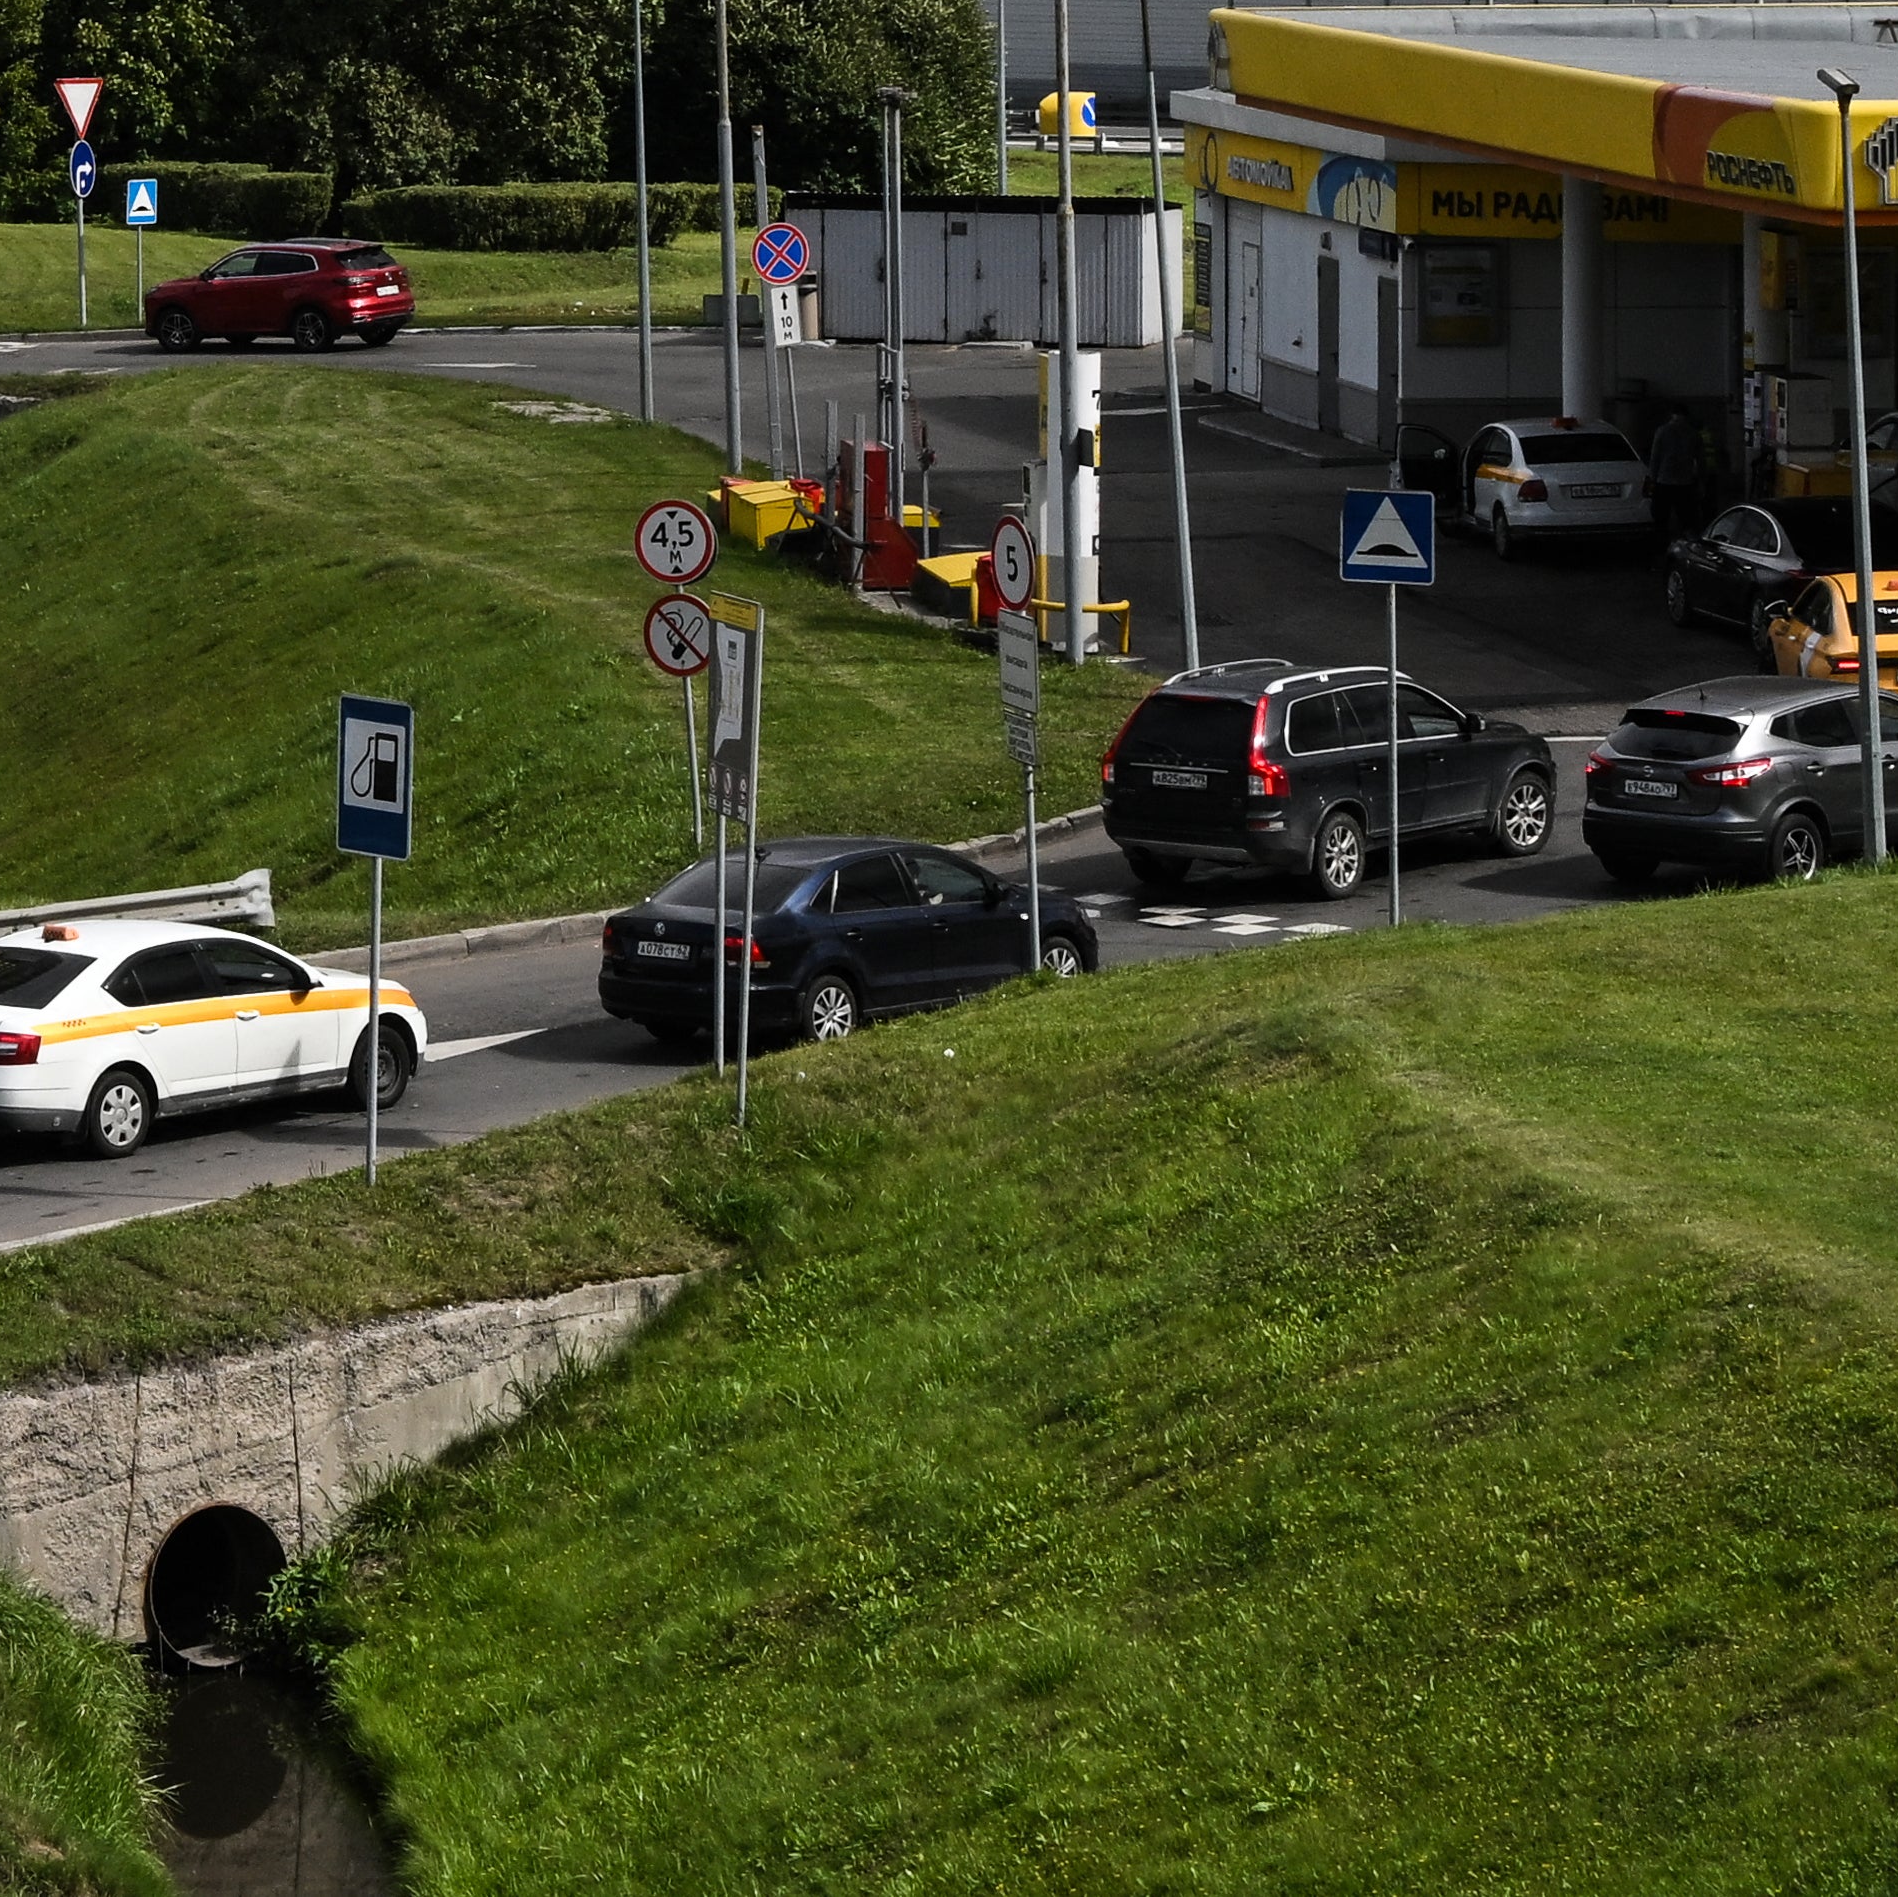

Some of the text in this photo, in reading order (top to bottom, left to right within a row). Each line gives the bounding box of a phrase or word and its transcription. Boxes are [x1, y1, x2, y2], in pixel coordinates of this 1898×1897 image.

[1706, 150, 1796, 195] РОСНЕФТЬ
[1432, 190, 1483, 217] МЫ
[781, 315, 793, 328] 10
[650, 520, 695, 548] 4,5
[1006, 545, 1019, 582] 5
